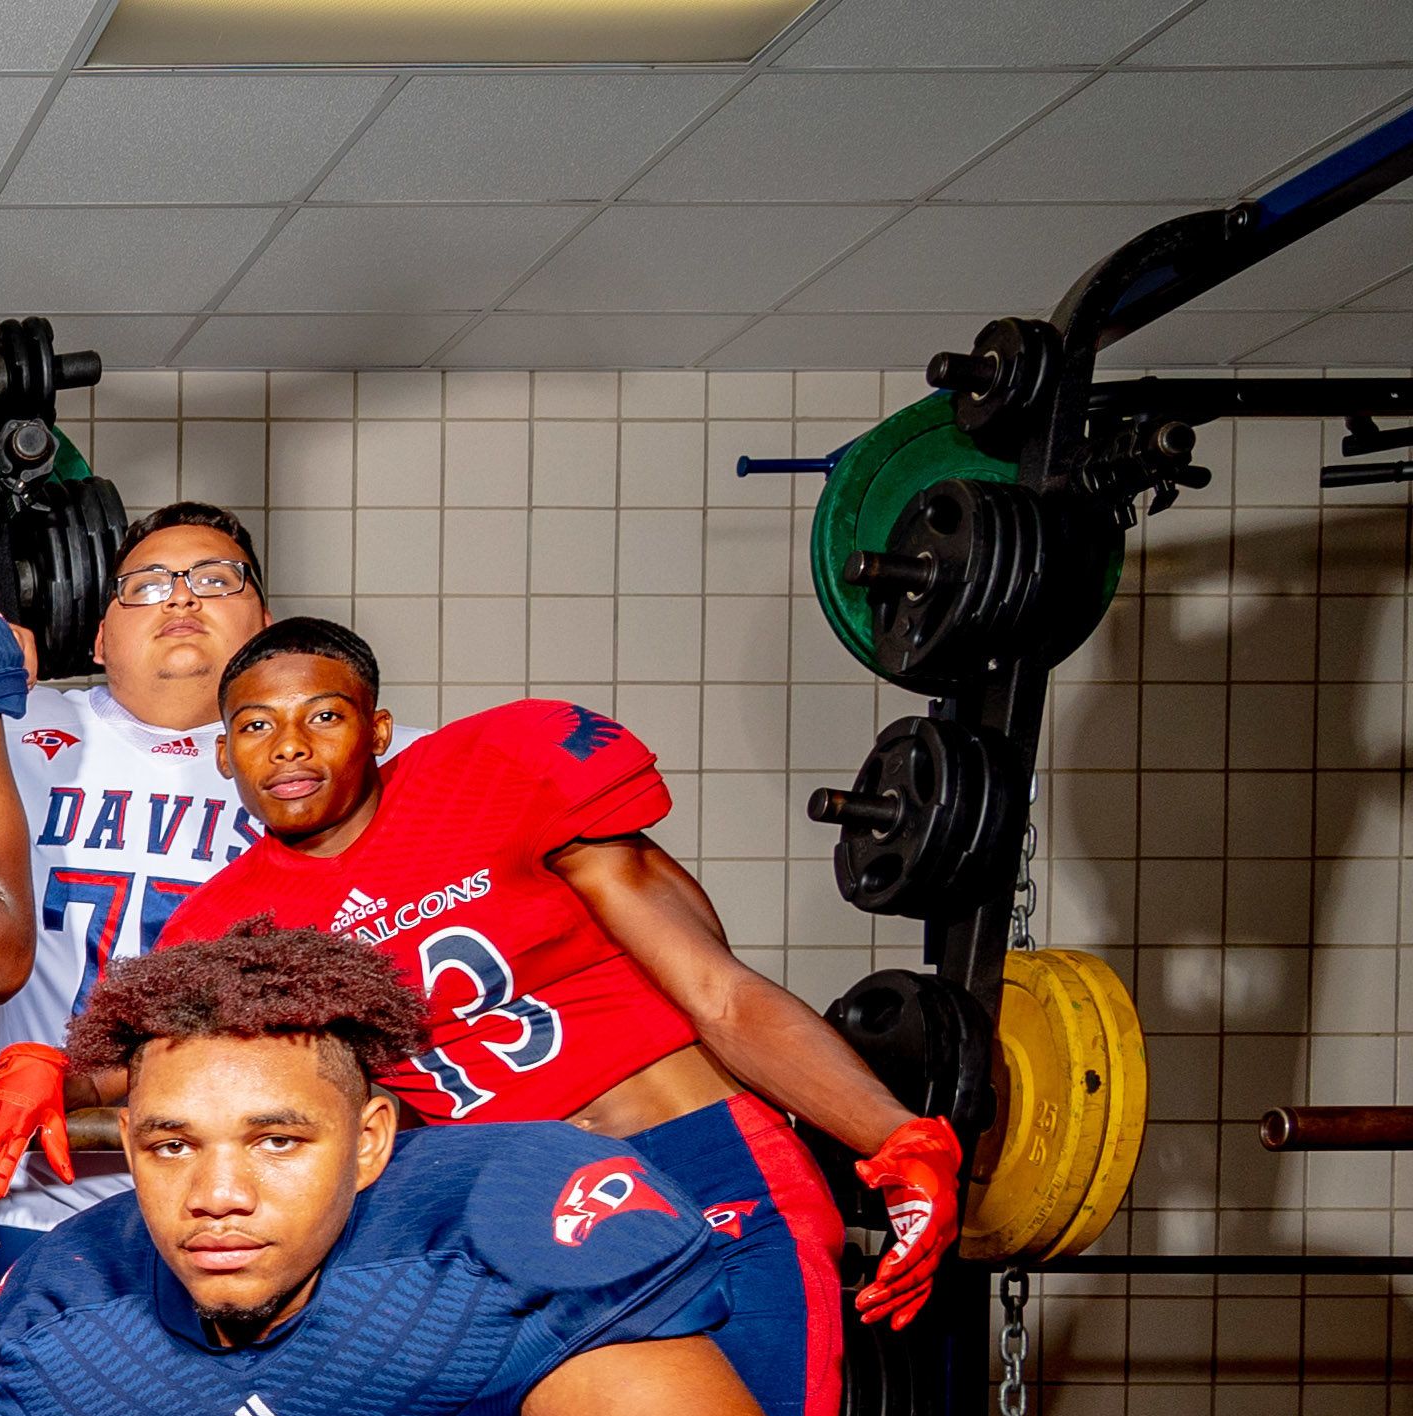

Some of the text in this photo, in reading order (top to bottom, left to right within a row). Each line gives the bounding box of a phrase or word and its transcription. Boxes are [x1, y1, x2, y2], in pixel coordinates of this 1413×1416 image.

[150, 742, 200, 758] adidas
[36, 786, 267, 865] DAVIS
[330, 896, 389, 933] adidas
[340, 868, 492, 947] ALCONS
